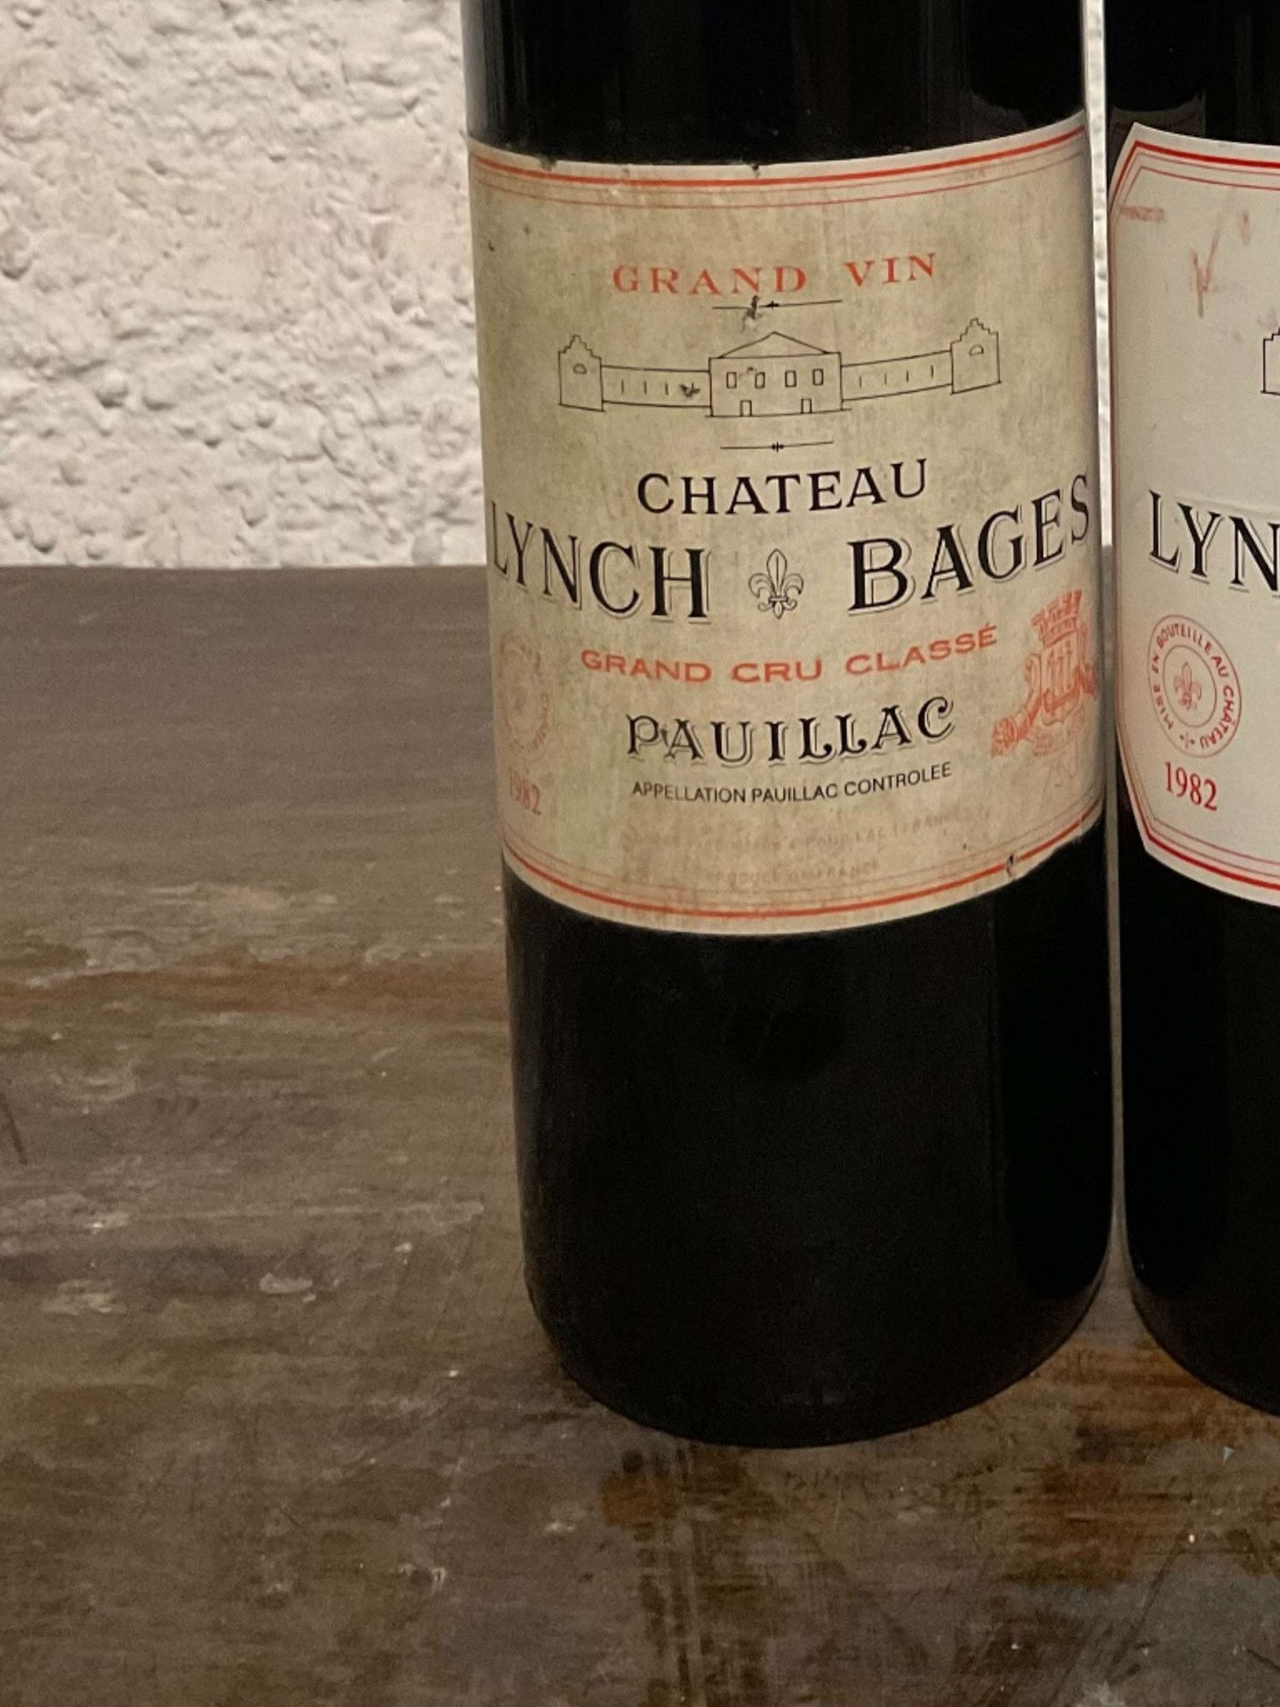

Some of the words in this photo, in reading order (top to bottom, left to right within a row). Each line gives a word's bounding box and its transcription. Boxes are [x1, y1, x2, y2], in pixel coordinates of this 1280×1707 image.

[613, 263, 808, 297] GRAND
[844, 252, 938, 287] VIN
[637, 458, 929, 516] CHATEAU
[489, 500, 713, 622] LYNCH
[847, 473, 1091, 620] BAGES
[580, 648, 713, 684] GRAND
[731, 658, 824, 684] CRU
[845, 624, 999, 677] CLASSÉ
[1156, 623, 1213, 655] BOUTEILLE
[1210, 654, 1230, 678] AU
[624, 695, 956, 769] PAUILLAC
[631, 780, 747, 804] APPELLATION
[751, 782, 839, 804] PAUILLAC
[844, 762, 952, 797] CONTROLEE
[1164, 761, 1218, 812] 1982
